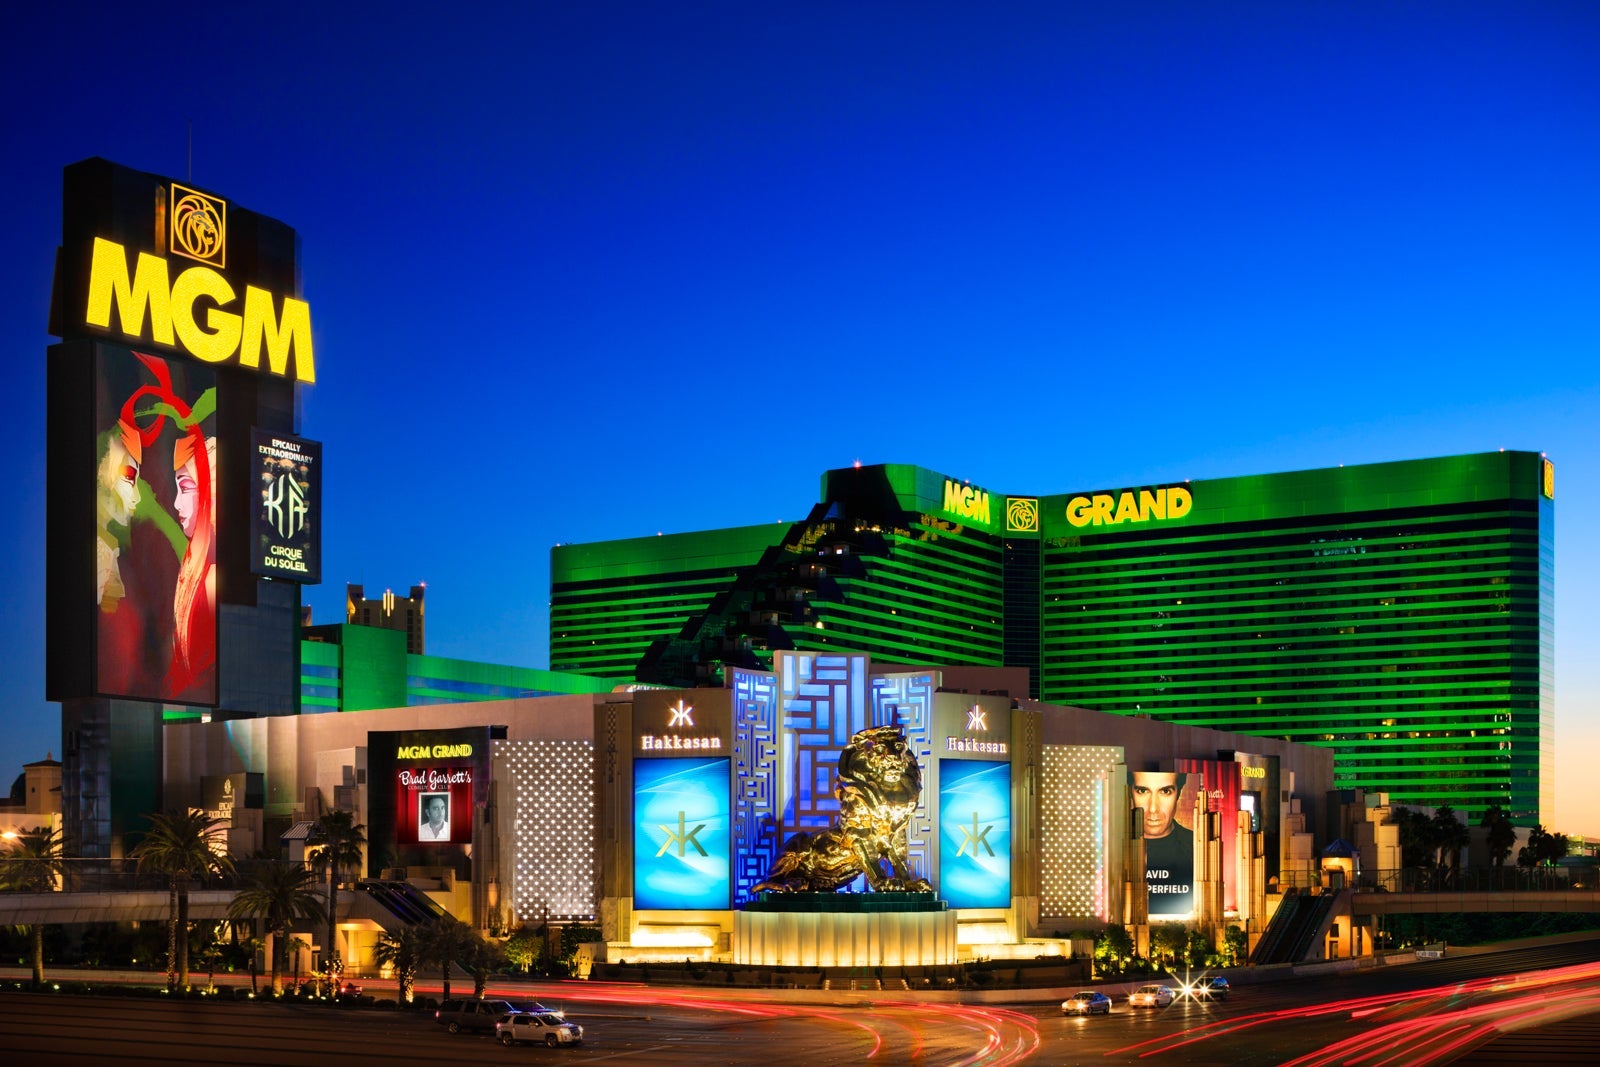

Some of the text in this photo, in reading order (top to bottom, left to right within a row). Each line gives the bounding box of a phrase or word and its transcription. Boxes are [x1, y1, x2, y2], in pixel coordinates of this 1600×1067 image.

[86, 236, 316, 384] MGM
[272, 439, 301, 452] EPICALLY
[258, 445, 313, 463] EXTRAORDINARY
[943, 479, 991, 525] MGM
[1065, 487, 1193, 528] GRAND
[270, 545, 303, 560] CIRQUE
[264, 556, 308, 572] DU SOLEIL
[641, 735, 721, 750] Hakkasan
[946, 737, 1007, 753] Hakkasan
[397, 744, 473, 759] MGM GRAND
[398, 770, 472, 790] Brad Garrett's
[1146, 869, 1169, 879] AVID
[1147, 884, 1189, 894] PERFIELD
